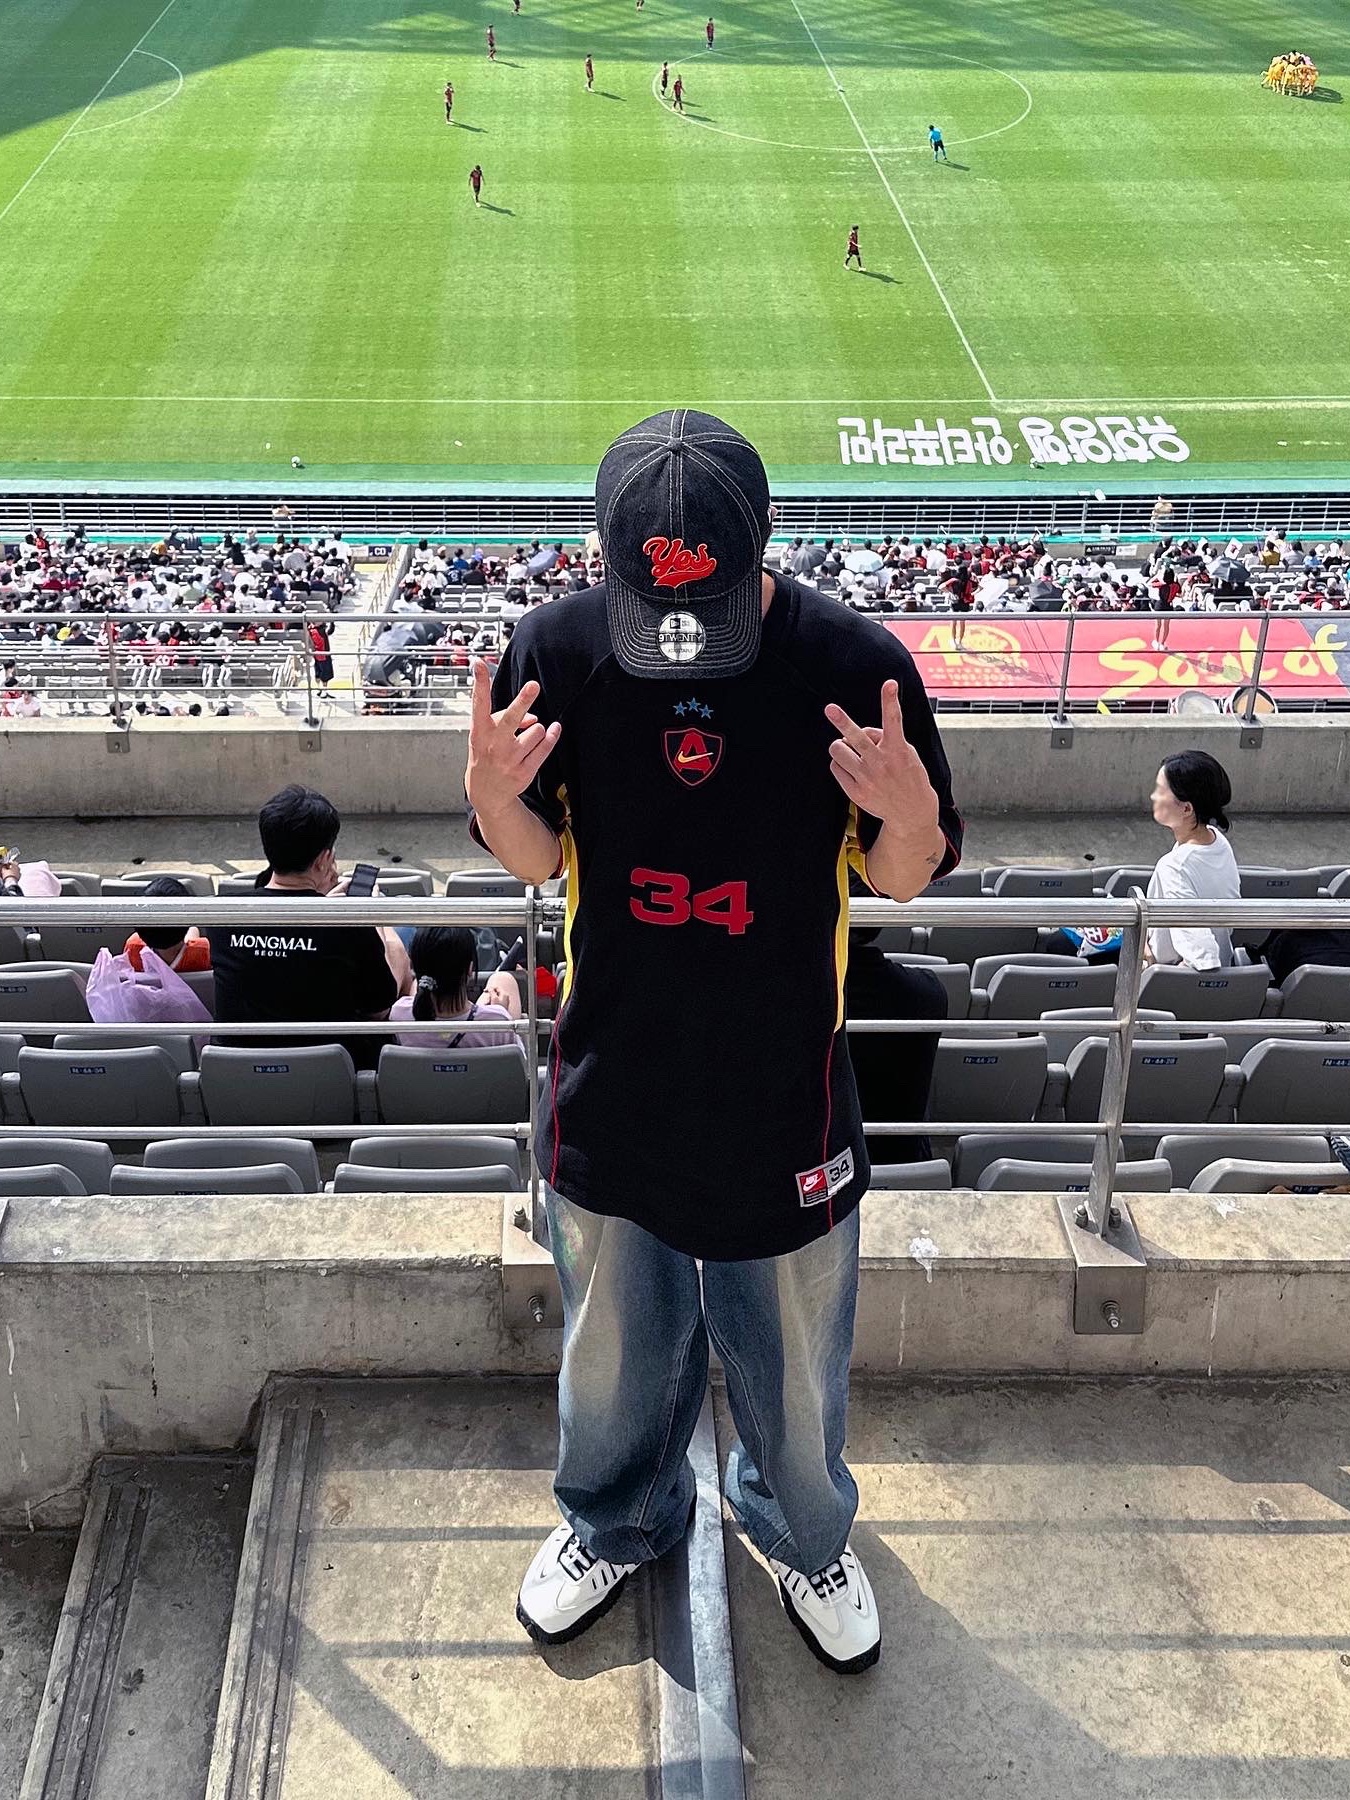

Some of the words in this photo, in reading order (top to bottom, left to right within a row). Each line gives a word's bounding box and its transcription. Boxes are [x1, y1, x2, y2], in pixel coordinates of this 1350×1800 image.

[837, 416, 1013, 466] 안티푸라민
[1018, 415, 1191, 467] 유한양행
[642, 536, 717, 580] Yes
[630, 867, 754, 935] 34
[230, 934, 317, 951] MONGMAL
[254, 949, 287, 957] SEOUL
[829, 1160, 850, 1182] 34
